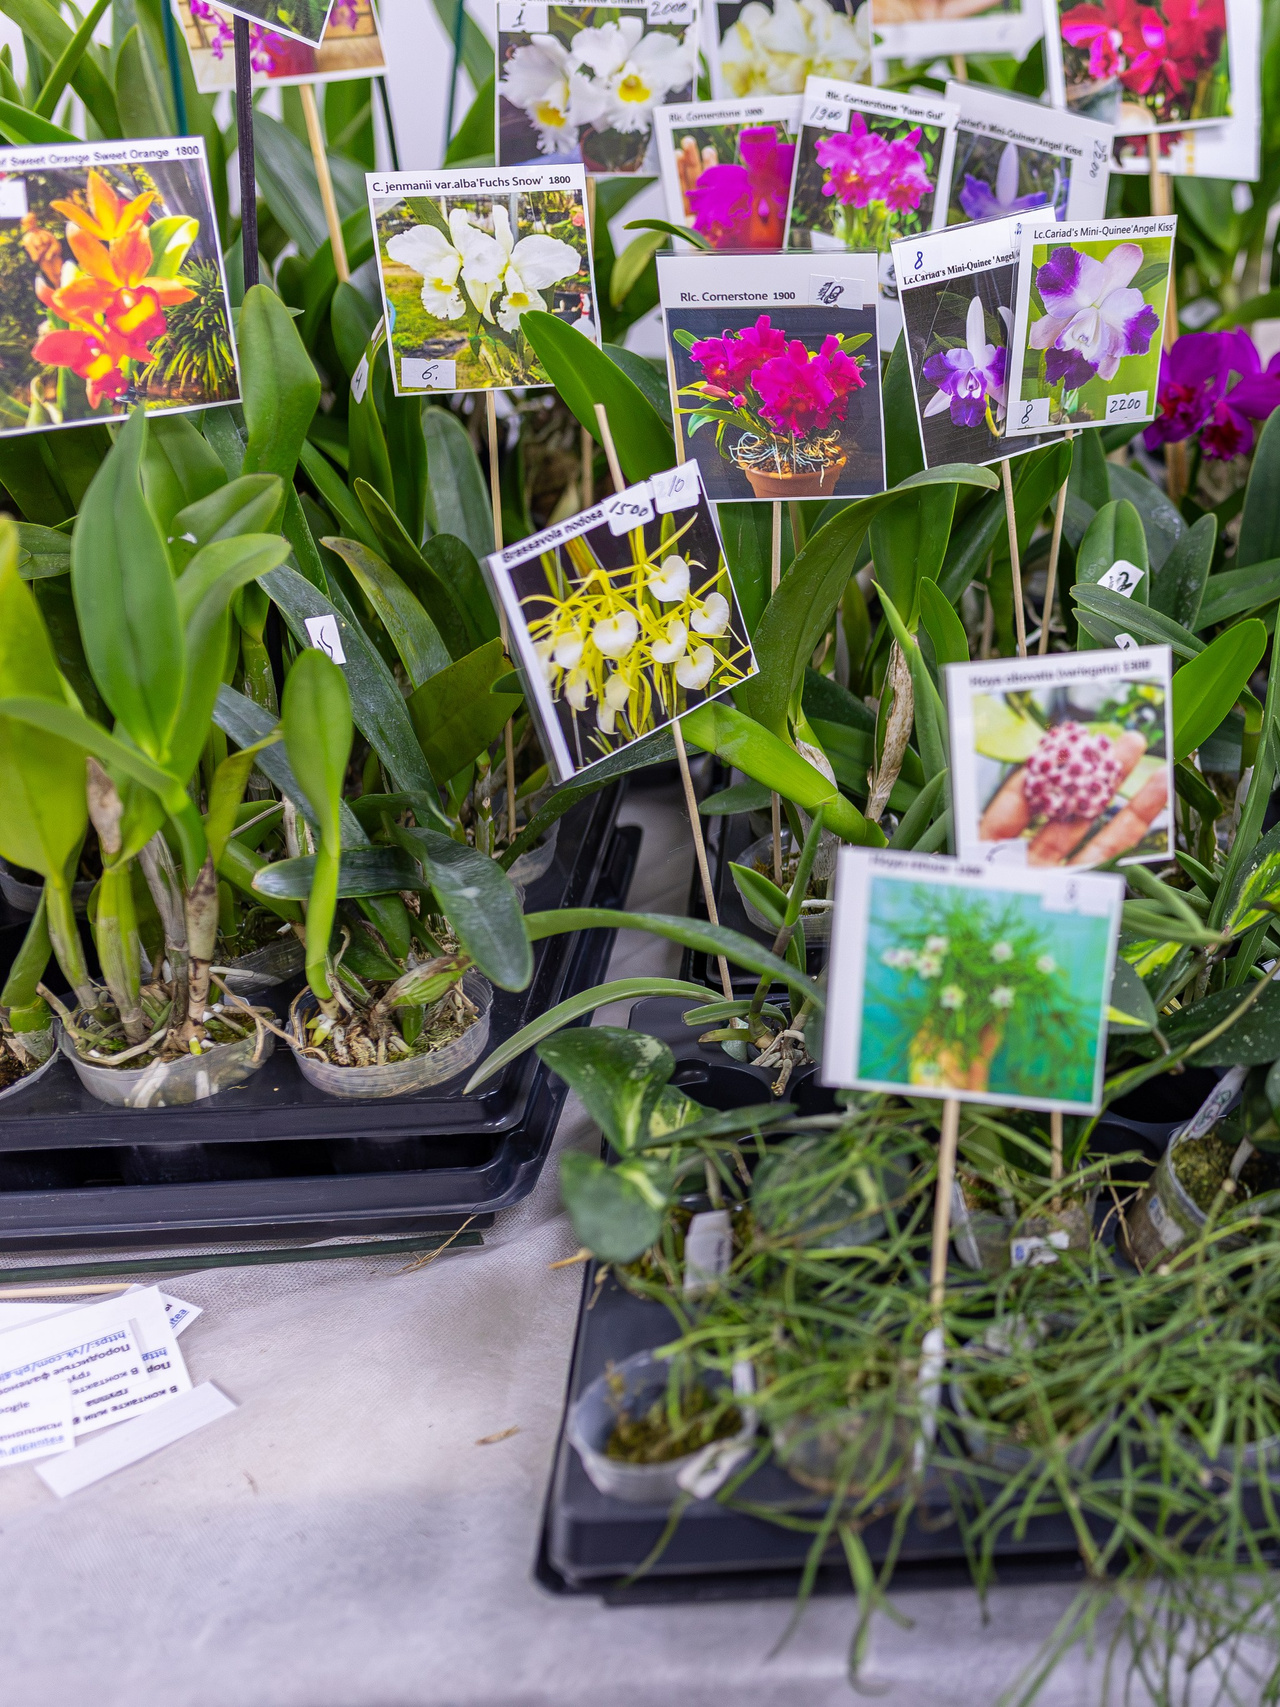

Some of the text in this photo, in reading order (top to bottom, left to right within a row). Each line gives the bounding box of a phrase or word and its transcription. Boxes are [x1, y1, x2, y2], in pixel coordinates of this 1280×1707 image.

[843, 94, 897, 112] Cornerstone
[94, 151, 128, 161] Sweet
[130, 149, 170, 160] Orange
[175, 145, 200, 156] 1800
[372, 182, 384, 192] C.
[385, 179, 432, 194] jenmanii
[513, 176, 544, 186] Snow'
[549, 175, 571, 184] 1800
[1033, 228, 1079, 240] Lc.Cariad's
[1158, 222, 1176, 232] Kiss'
[914, 251, 924, 270] 8
[903, 269, 946, 285] Lc.Cariad's
[947, 259, 992, 275] Mini-Quinee
[680, 291, 796, 302] Rlc. Cornerstone 1900
[1021, 403, 1034, 424] 8
[1109, 398, 1141, 414] 2200
[609, 501, 649, 518] 1500
[503, 509, 604, 564] Brassavola nodosa
